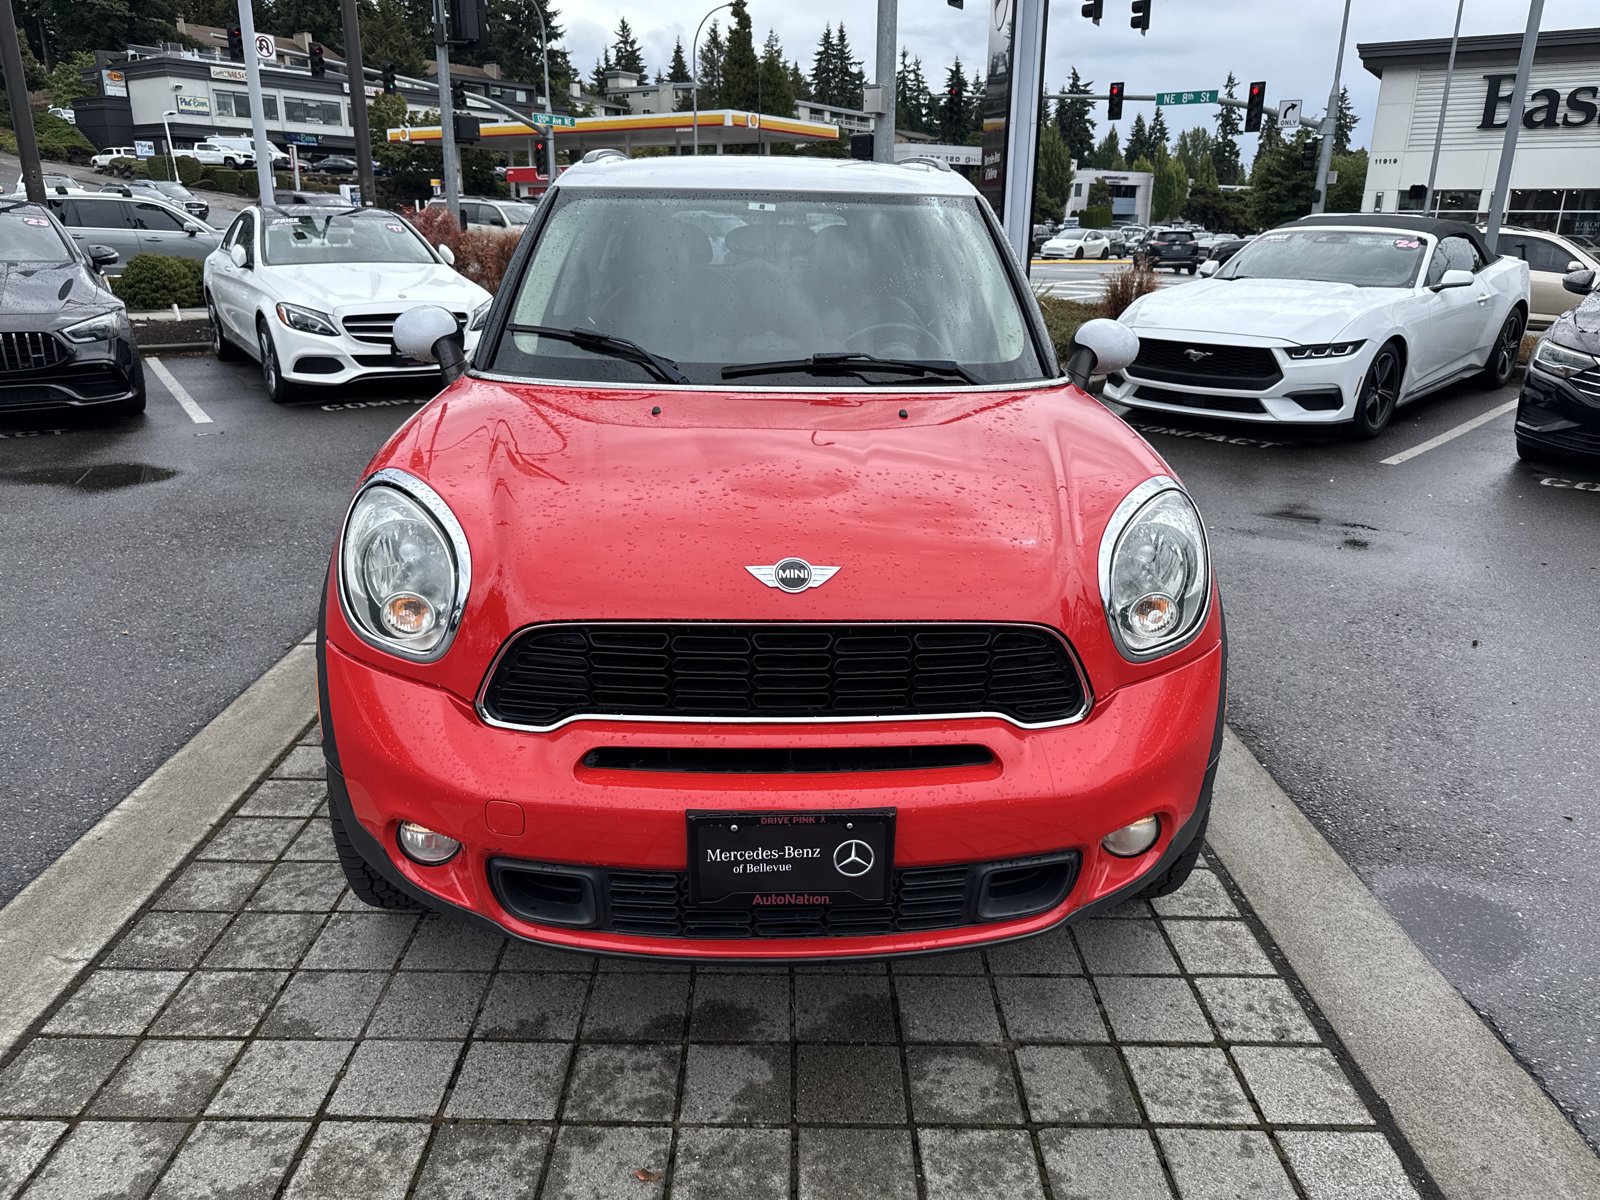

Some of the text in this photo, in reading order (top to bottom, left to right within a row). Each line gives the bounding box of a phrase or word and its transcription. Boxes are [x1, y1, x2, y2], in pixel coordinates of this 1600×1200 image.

[1163, 91, 1210, 104] NE 8th St
[1477, 74, 1600, 129] Bas
[538, 115, 573, 126] 120th Ave NE
[321, 399, 429, 411] COMPA
[1539, 477, 1600, 491] CO
[778, 569, 808, 579] MINI
[760, 816, 816, 825] DRIVE PINK
[706, 845, 821, 862] Mercedes-Benz
[733, 862, 792, 873] of Bellevue
[752, 894, 830, 905] AutoNation
